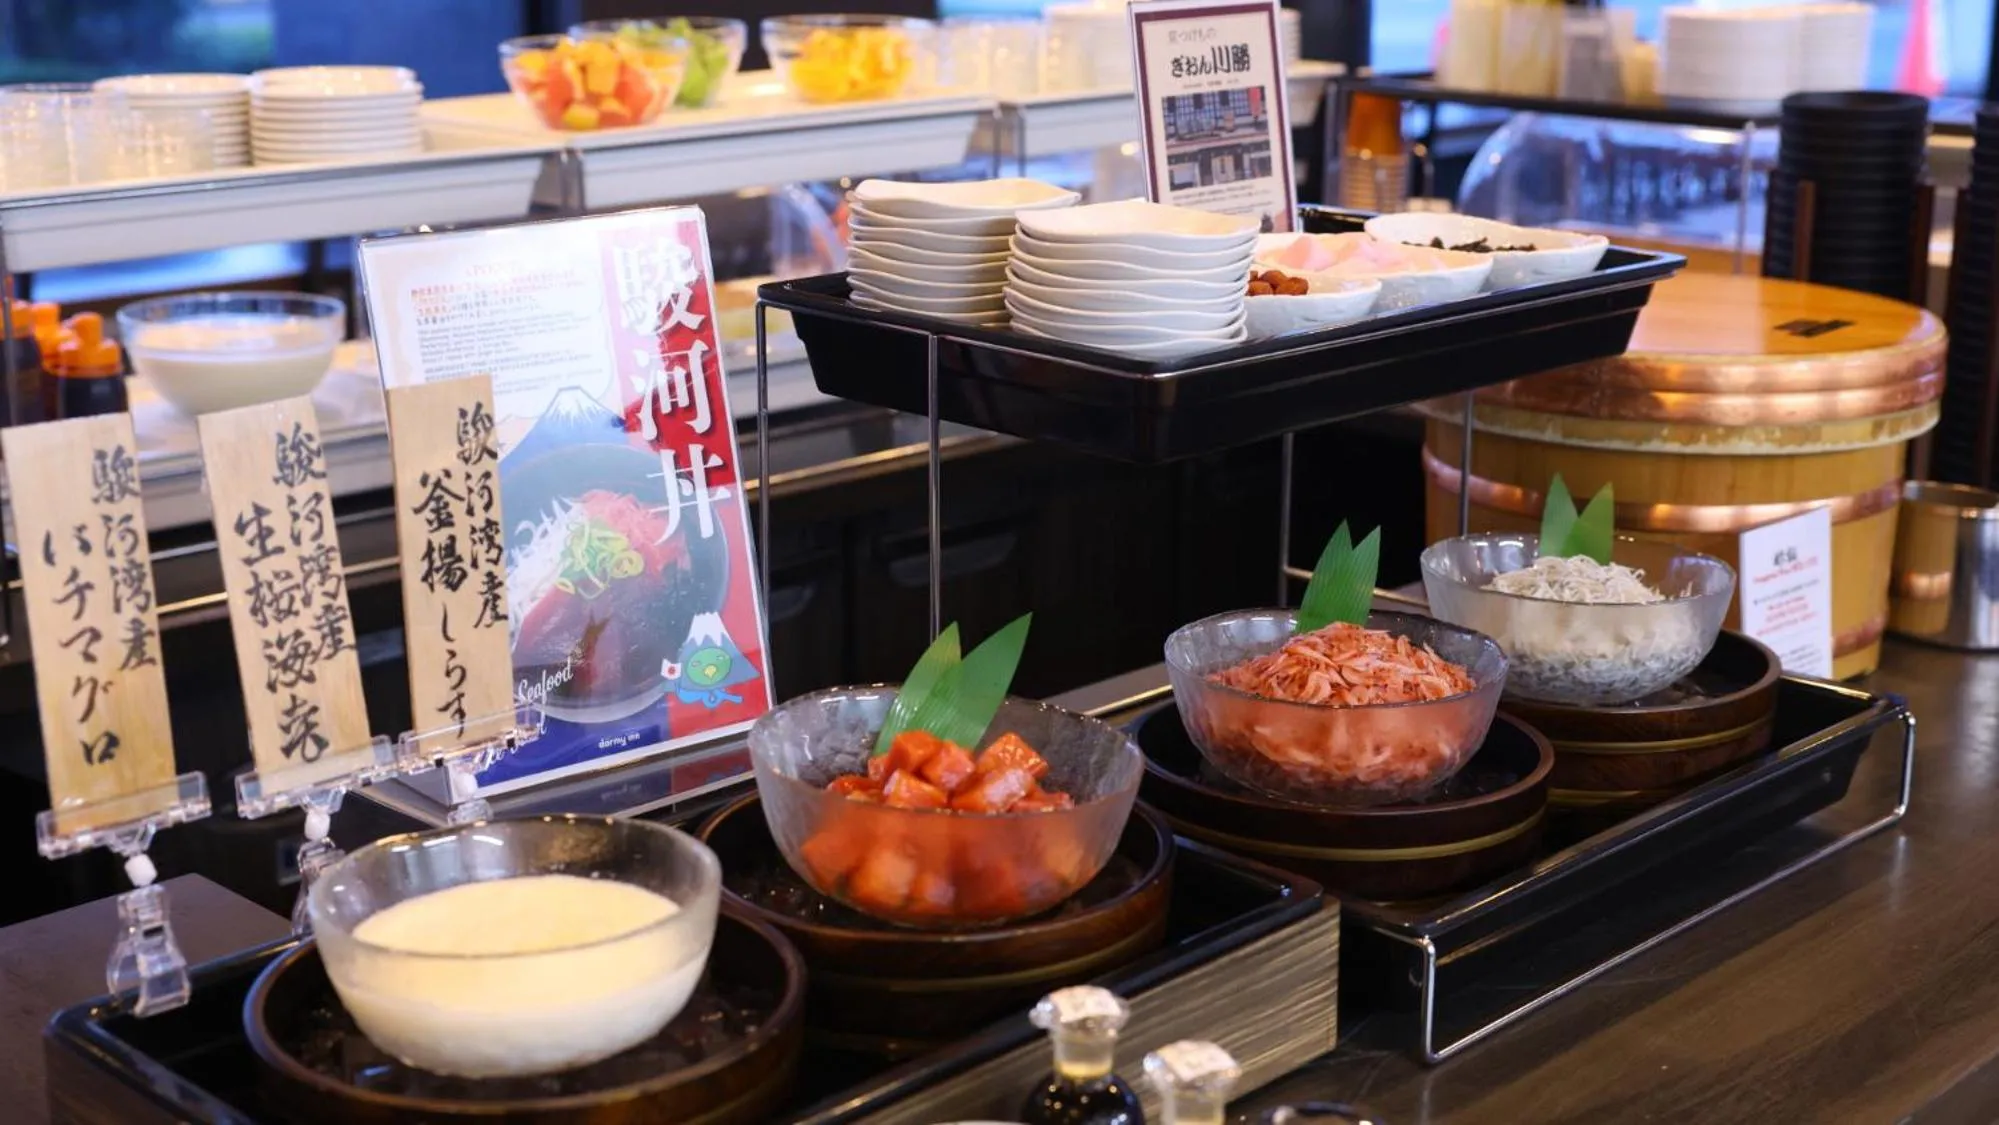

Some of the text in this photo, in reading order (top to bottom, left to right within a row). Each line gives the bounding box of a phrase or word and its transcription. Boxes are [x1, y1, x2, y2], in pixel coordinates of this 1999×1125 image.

[1171, 43, 1250, 78] ぎおん川勝
[613, 237, 732, 547] 駿河丼
[91, 445, 157, 671] 駿河湾産
[273, 422, 357, 661] 駿河湾産
[412, 468, 467, 740] 釜揚しらす
[457, 401, 509, 629] 駿河湾産
[43, 525, 121, 766] バチマグロ
[234, 502, 330, 764] 生桜海老
[516, 656, 574, 705] Seafood
[598, 736, 627, 749] dormy
